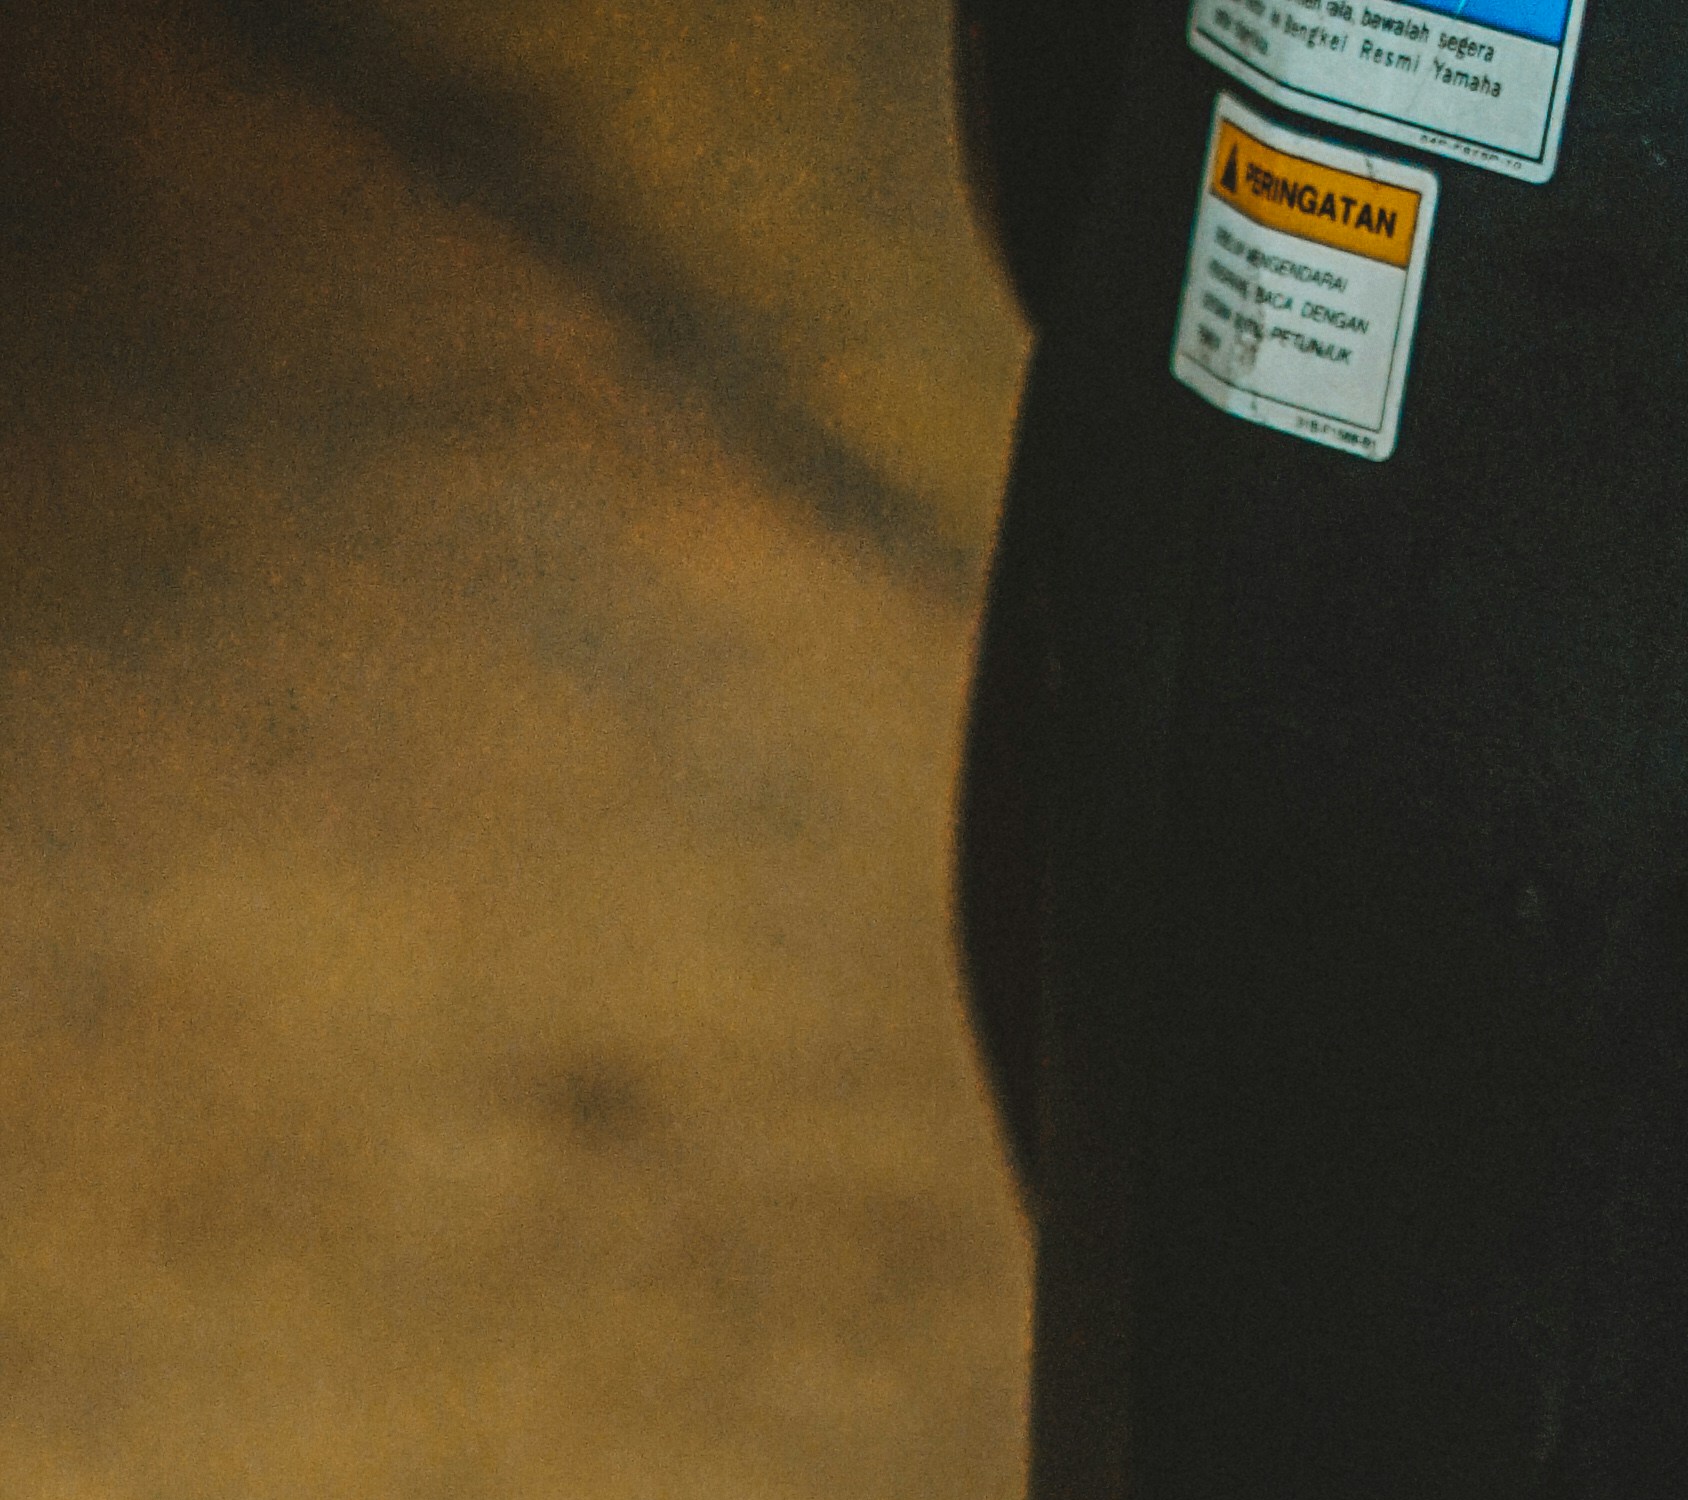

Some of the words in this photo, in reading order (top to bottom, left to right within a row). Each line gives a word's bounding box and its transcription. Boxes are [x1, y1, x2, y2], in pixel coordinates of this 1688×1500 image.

[1362, 7, 1430, 43] bawalah
[1438, 32, 1495, 63] segera
[1360, 38, 1421, 73] Resmi
[1433, 57, 1502, 98] Yamaha
[1246, 163, 1398, 238] PERINGATAN
[1302, 301, 1370, 335] DENGAN
